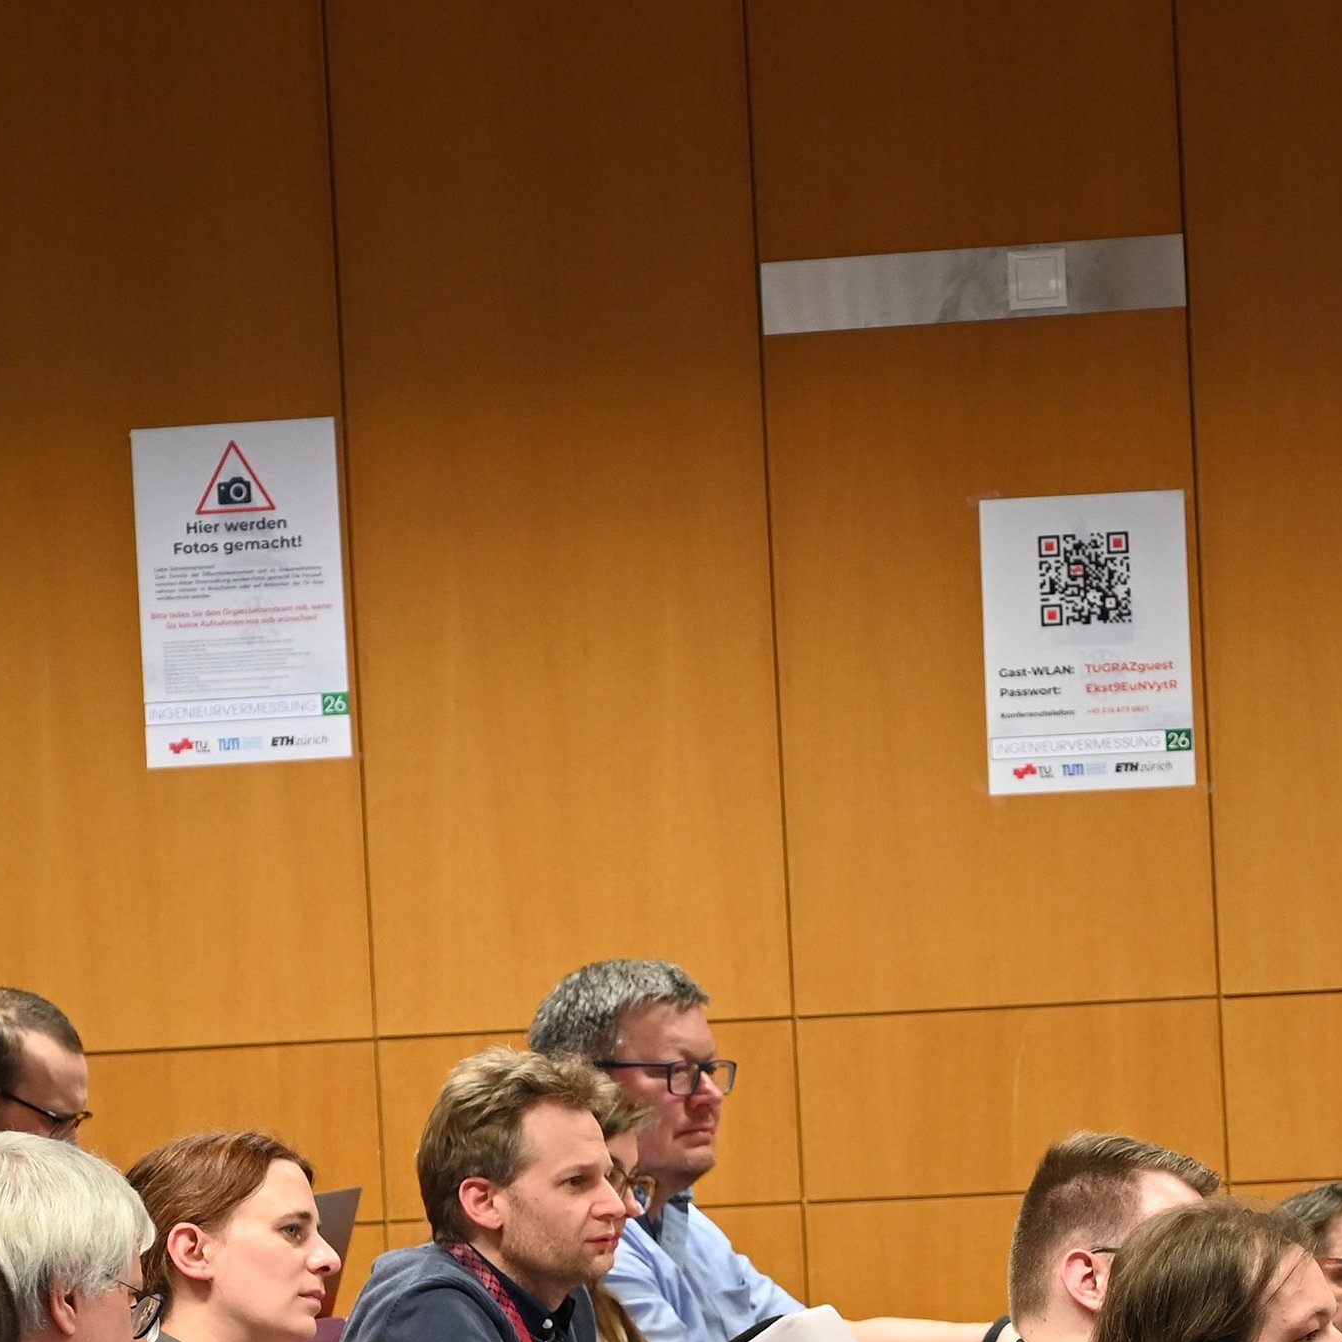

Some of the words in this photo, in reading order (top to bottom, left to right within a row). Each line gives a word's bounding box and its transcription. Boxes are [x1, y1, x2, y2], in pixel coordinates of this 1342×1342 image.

[186, 519, 219, 534] Hier
[225, 517, 287, 533] werden
[173, 541, 218, 555] Fotos
[223, 535, 302, 555] gemacht!
[999, 665, 1075, 678] Gast-WLAN:
[1085, 660, 1173, 675] TUGRAZguest
[999, 686, 1062, 697] Passwort:
[149, 698, 316, 721] INGENIEURVERMESSUNG
[323, 695, 346, 713] 26
[271, 735, 295, 747] ETH
[996, 734, 1160, 755] INGENIEURVERMESSUNG
[1167, 731, 1190, 750] 26
[1115, 761, 1139, 773] ETH
